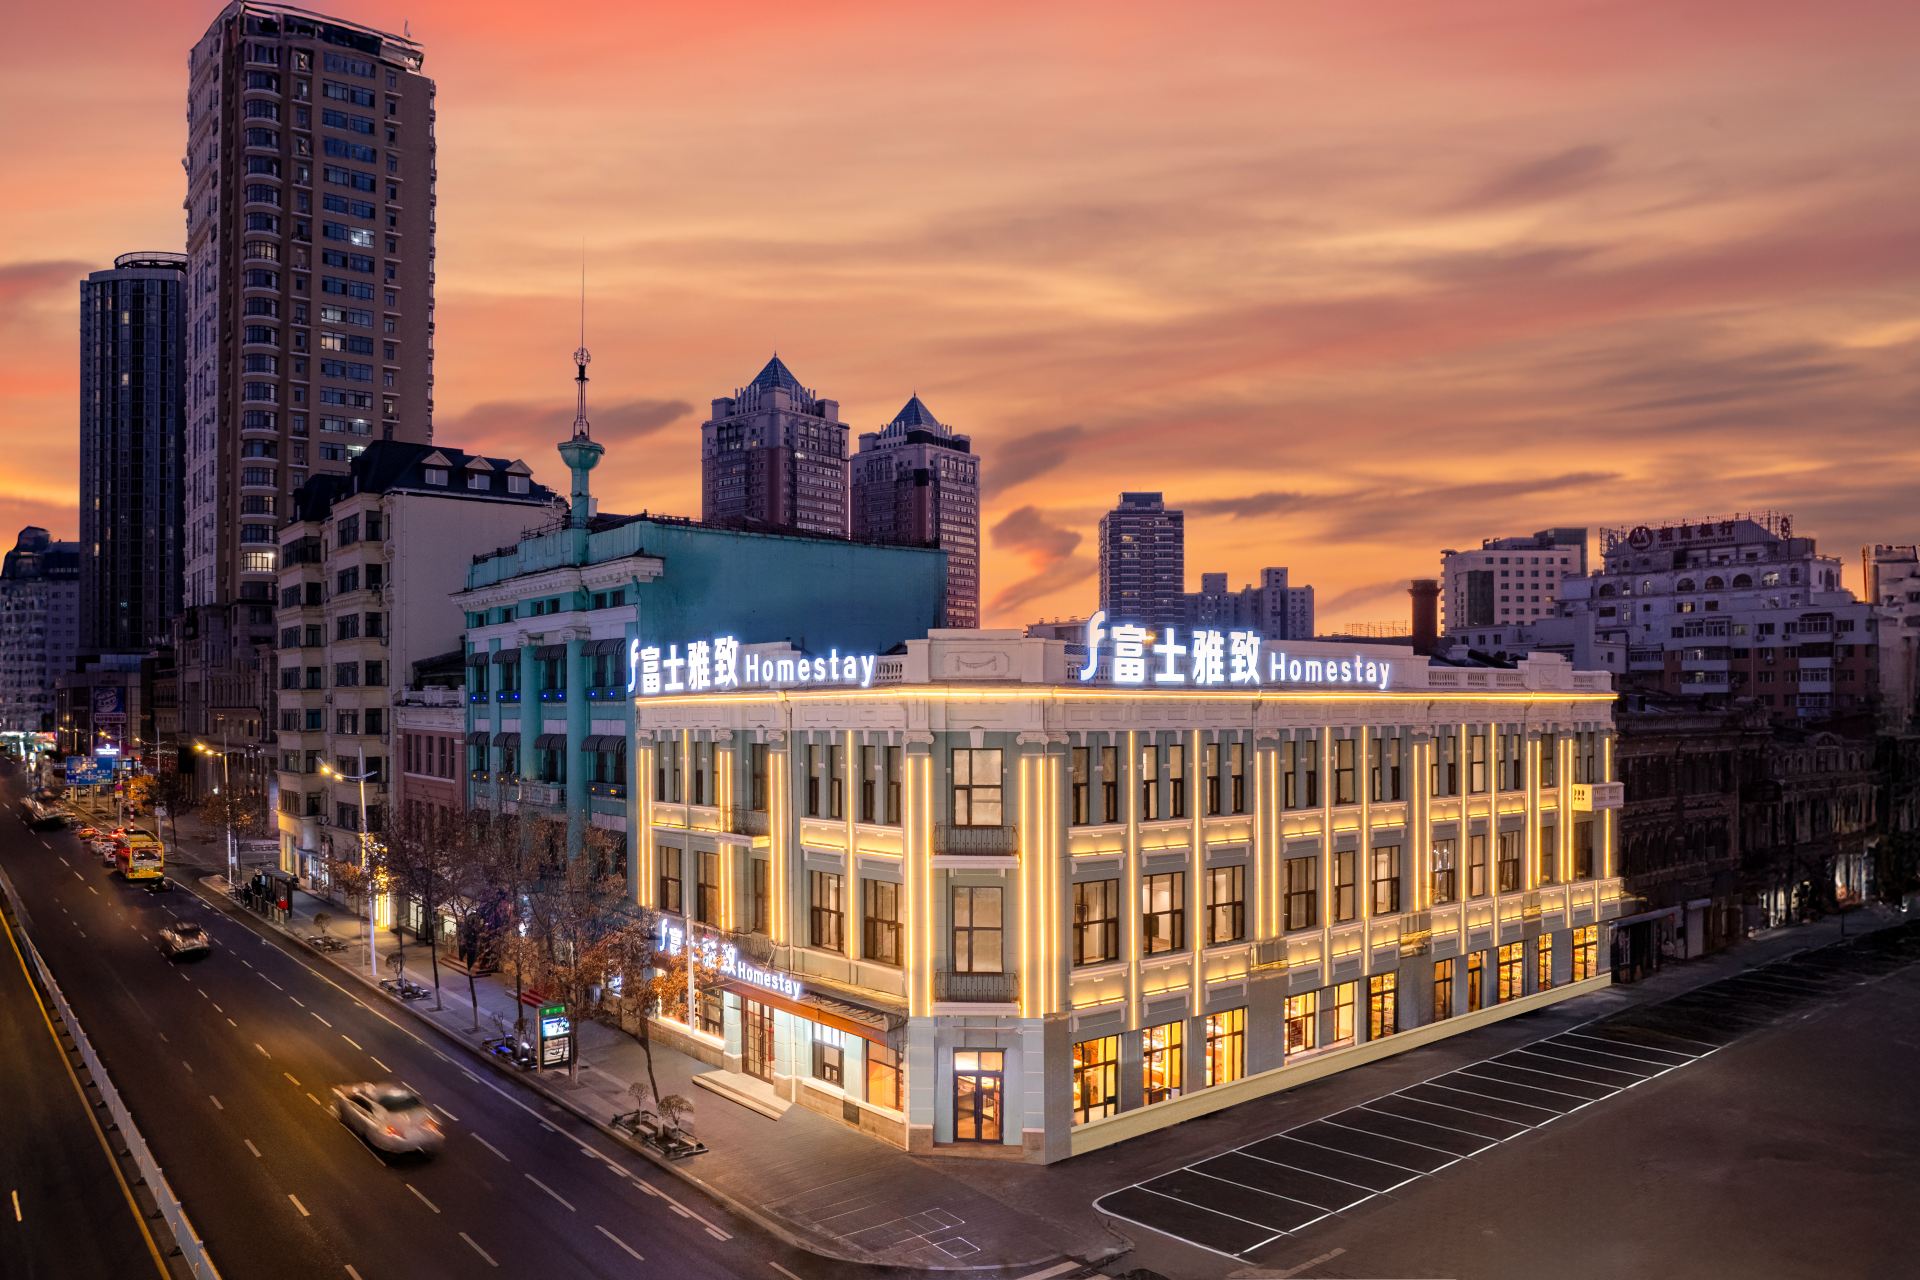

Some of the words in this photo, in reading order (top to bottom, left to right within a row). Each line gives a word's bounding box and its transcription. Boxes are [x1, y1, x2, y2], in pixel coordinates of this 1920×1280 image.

[641, 636, 739, 693] 富士雅致
[746, 648, 875, 686] Homestay
[1112, 624, 1260, 685] 富士雅致
[1271, 652, 1391, 690] Homestay
[738, 961, 800, 1000] Homestay
